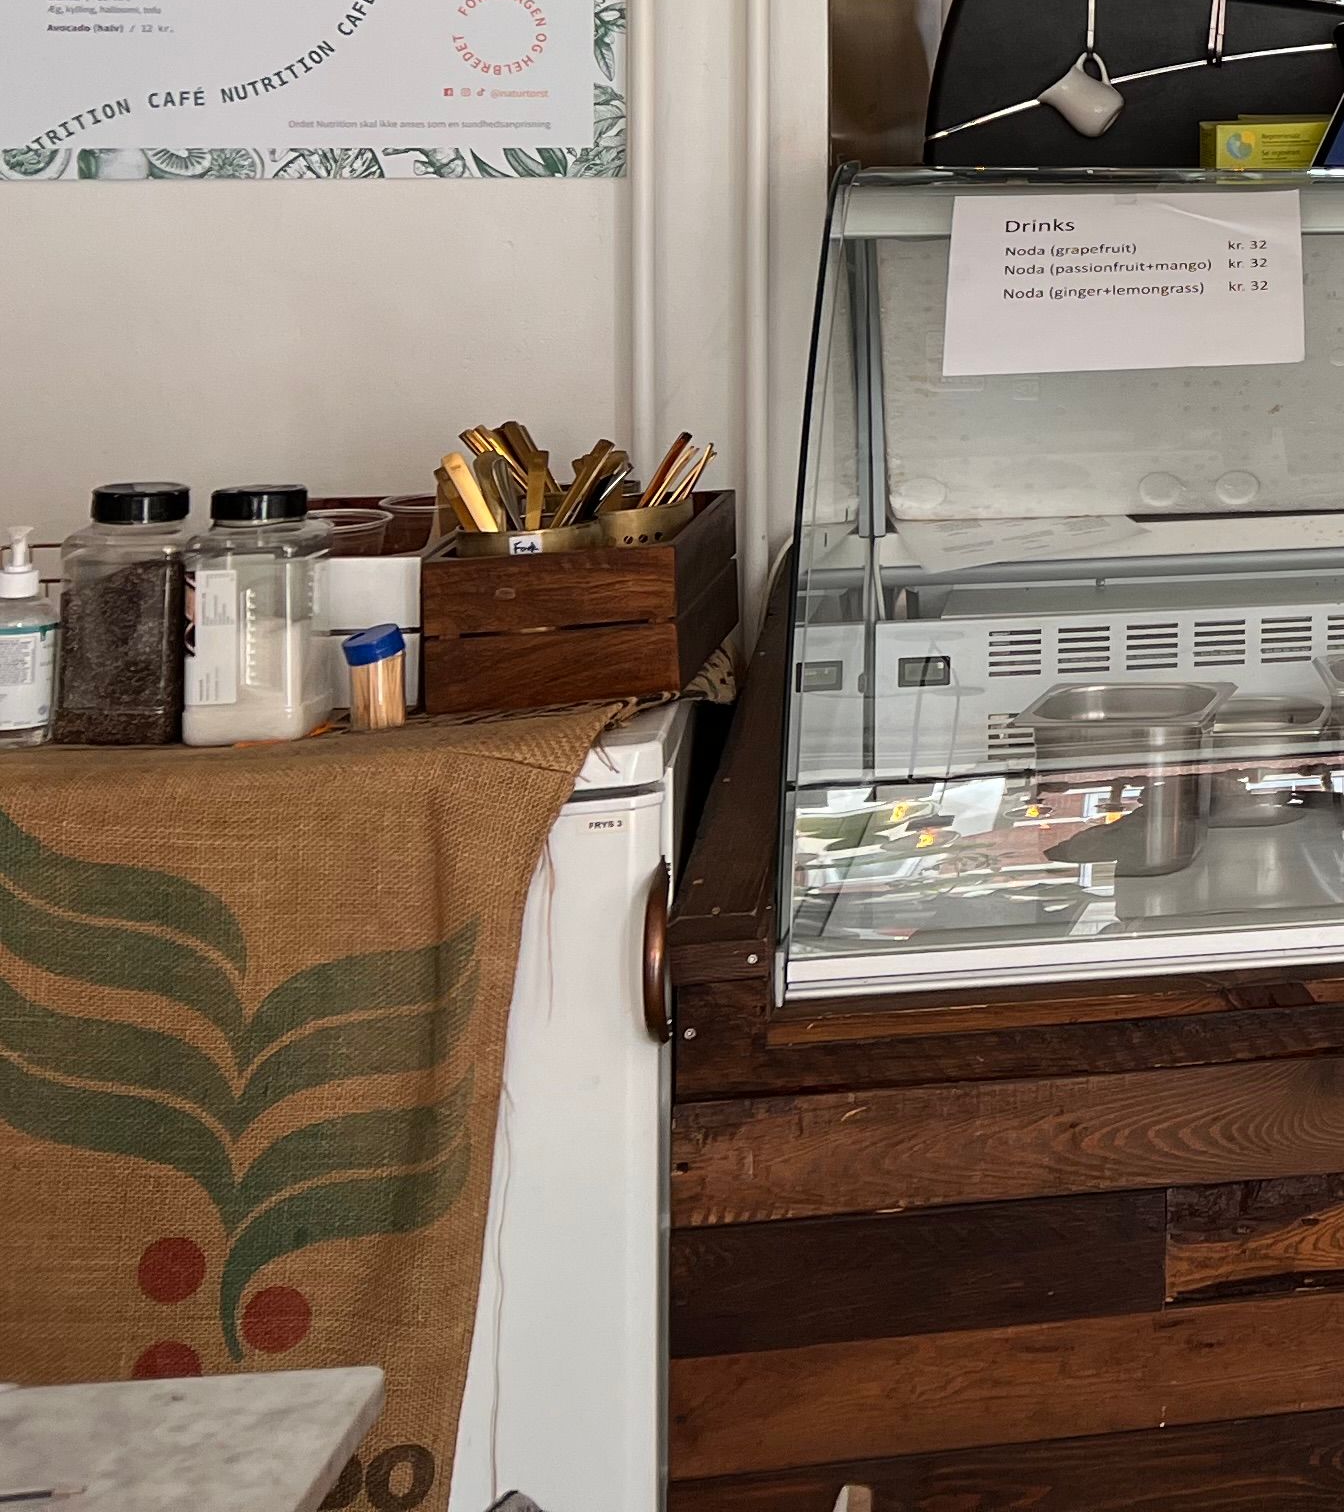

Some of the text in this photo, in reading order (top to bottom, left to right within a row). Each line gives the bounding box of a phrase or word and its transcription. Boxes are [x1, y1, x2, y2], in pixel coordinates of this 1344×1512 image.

[531, 32, 547, 54] OG
[452, 34, 534, 75] HELBREDET
[147, 86, 206, 110] CAFÉ
[220, 40, 336, 105] NUTRITION
[1005, 219, 1075, 233] Drinks
[1005, 240, 1267, 257] Noda (grapefruit) kr. 32
[1004, 265, 1044, 275] Noda
[1050, 260, 1211, 275] (passionfruit+mango)
[1250, 258, 1267, 268] 32
[1004, 281, 1268, 299] Noda (ginger+lemongrass) kr. 32
